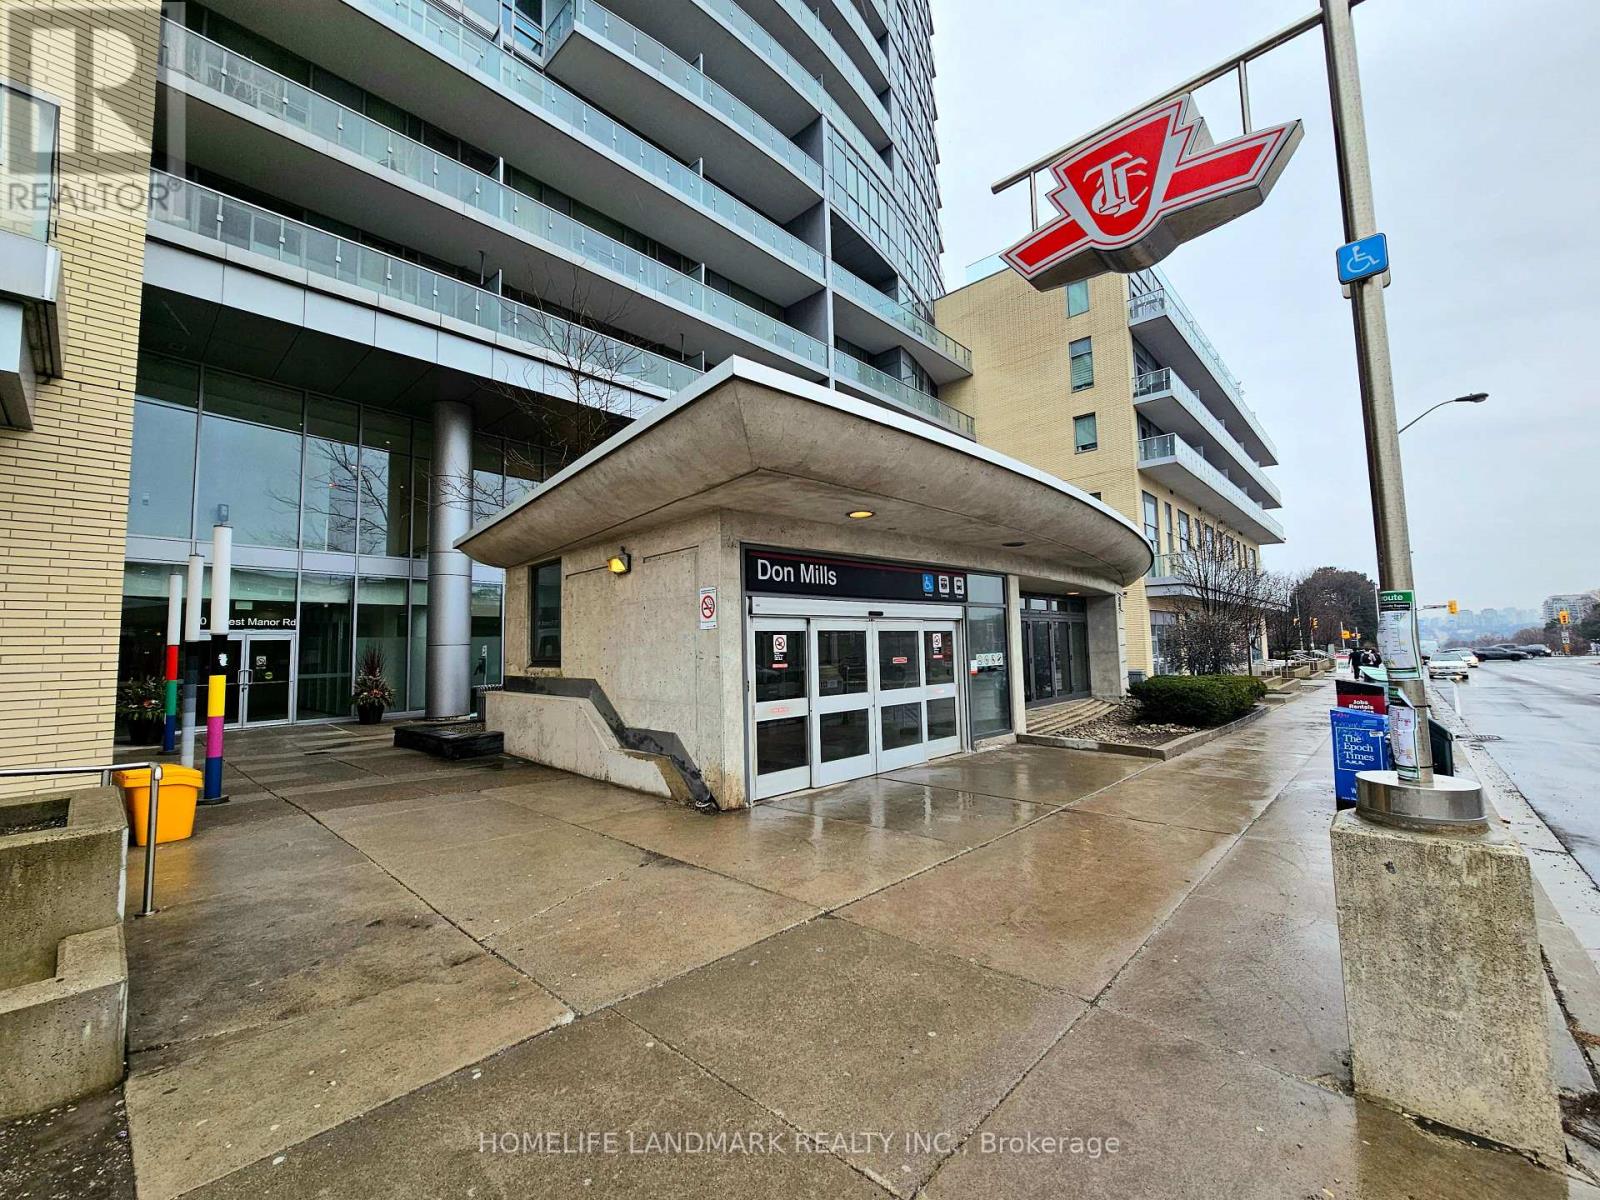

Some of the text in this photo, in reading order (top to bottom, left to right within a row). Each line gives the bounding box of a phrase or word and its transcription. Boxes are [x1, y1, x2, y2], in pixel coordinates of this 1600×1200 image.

[757, 559, 837, 586] Don Mills
[247, 617, 280, 626] Manor
[282, 618, 297, 626] Rd
[1342, 733, 1363, 743] The
[1343, 742, 1374, 753] Epoch
[1343, 751, 1375, 762] Times
